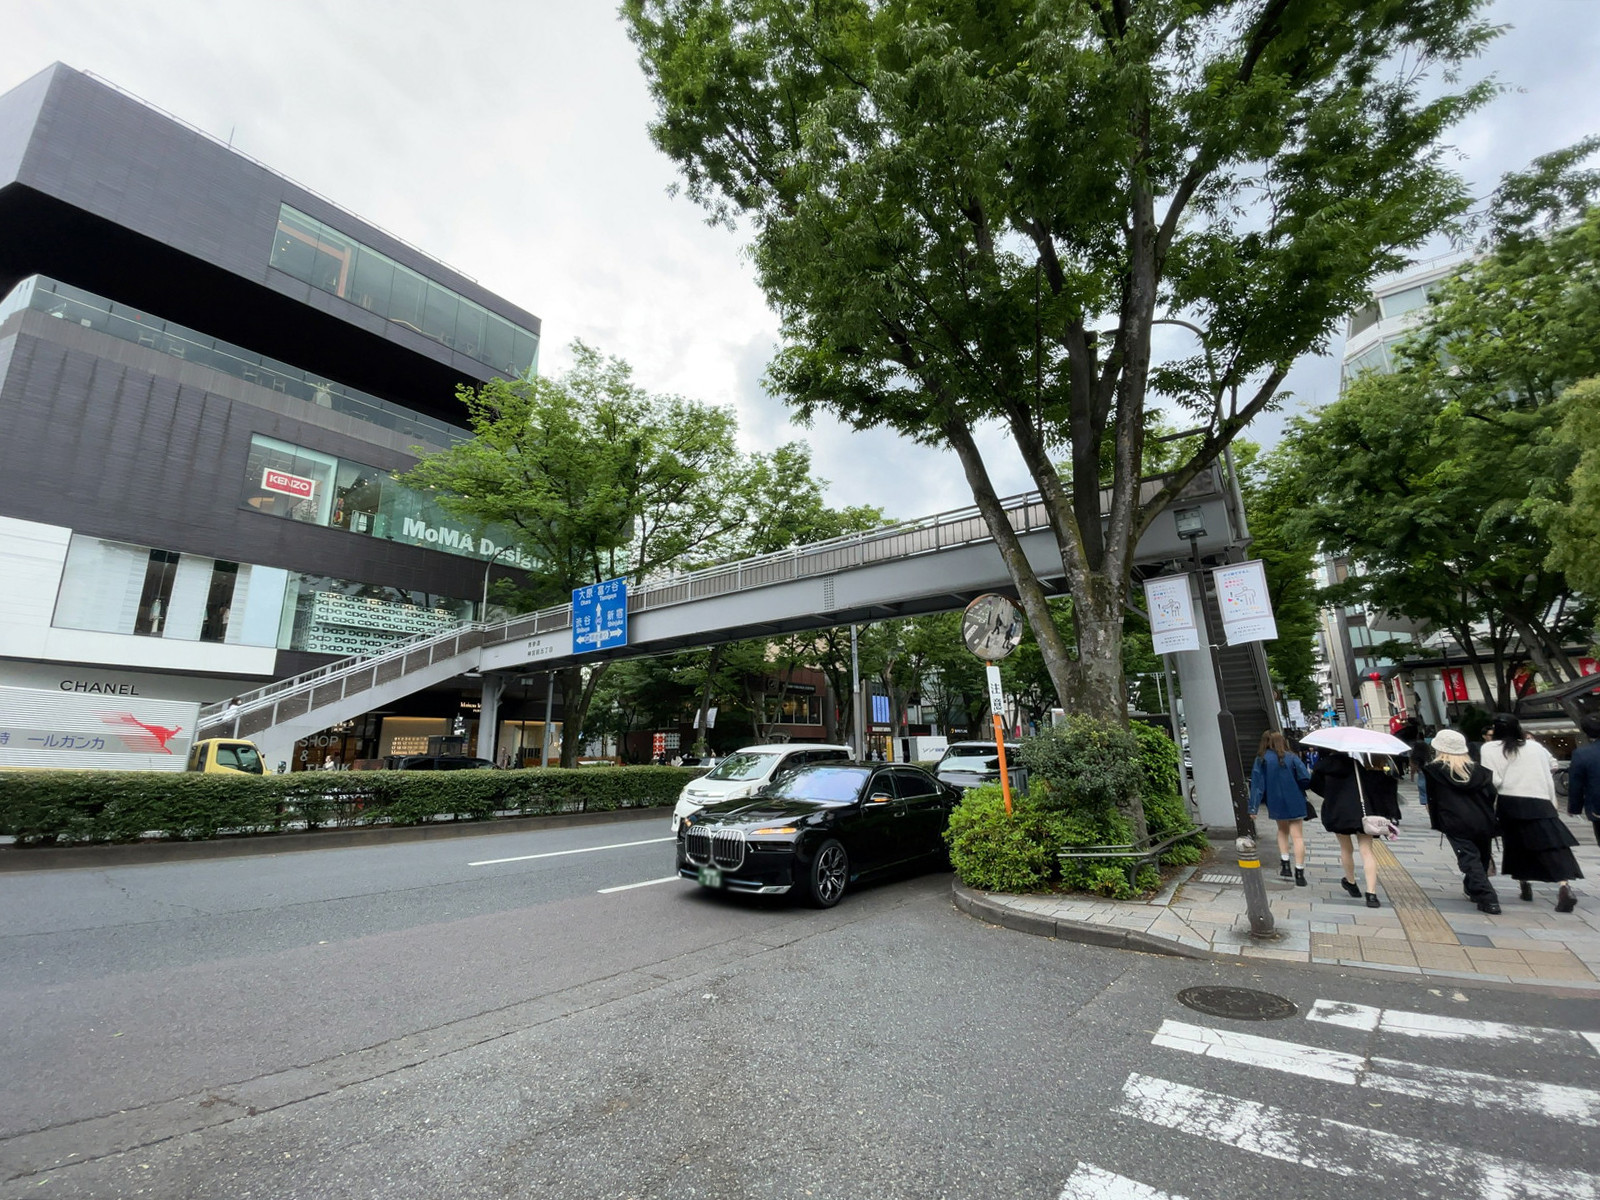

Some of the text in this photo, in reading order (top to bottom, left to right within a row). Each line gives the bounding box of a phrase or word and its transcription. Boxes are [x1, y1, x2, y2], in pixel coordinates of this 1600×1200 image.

[269, 474, 310, 491] KENZO
[402, 517, 474, 552] MoMA
[319, 592, 342, 600] CDG
[345, 596, 367, 604] CDG
[370, 600, 391, 608] CDG
[393, 602, 413, 610] CDG
[416, 606, 435, 614] CDG
[332, 601, 355, 609] CDG
[357, 605, 379, 613] CDG
[382, 608, 403, 616] CDG
[319, 607, 342, 615] CDG
[345, 610, 367, 618] CDG
[370, 614, 391, 622] CDG
[393, 617, 414, 625] CDG
[332, 616, 355, 624] CDG
[357, 619, 380, 628] CDG
[381, 623, 403, 631] CDG
[59, 680, 140, 696] CHANEL
[990, 683, 1002, 711] 注意
[298, 735, 339, 747] SHOP
[300, 749, 309, 762] &
